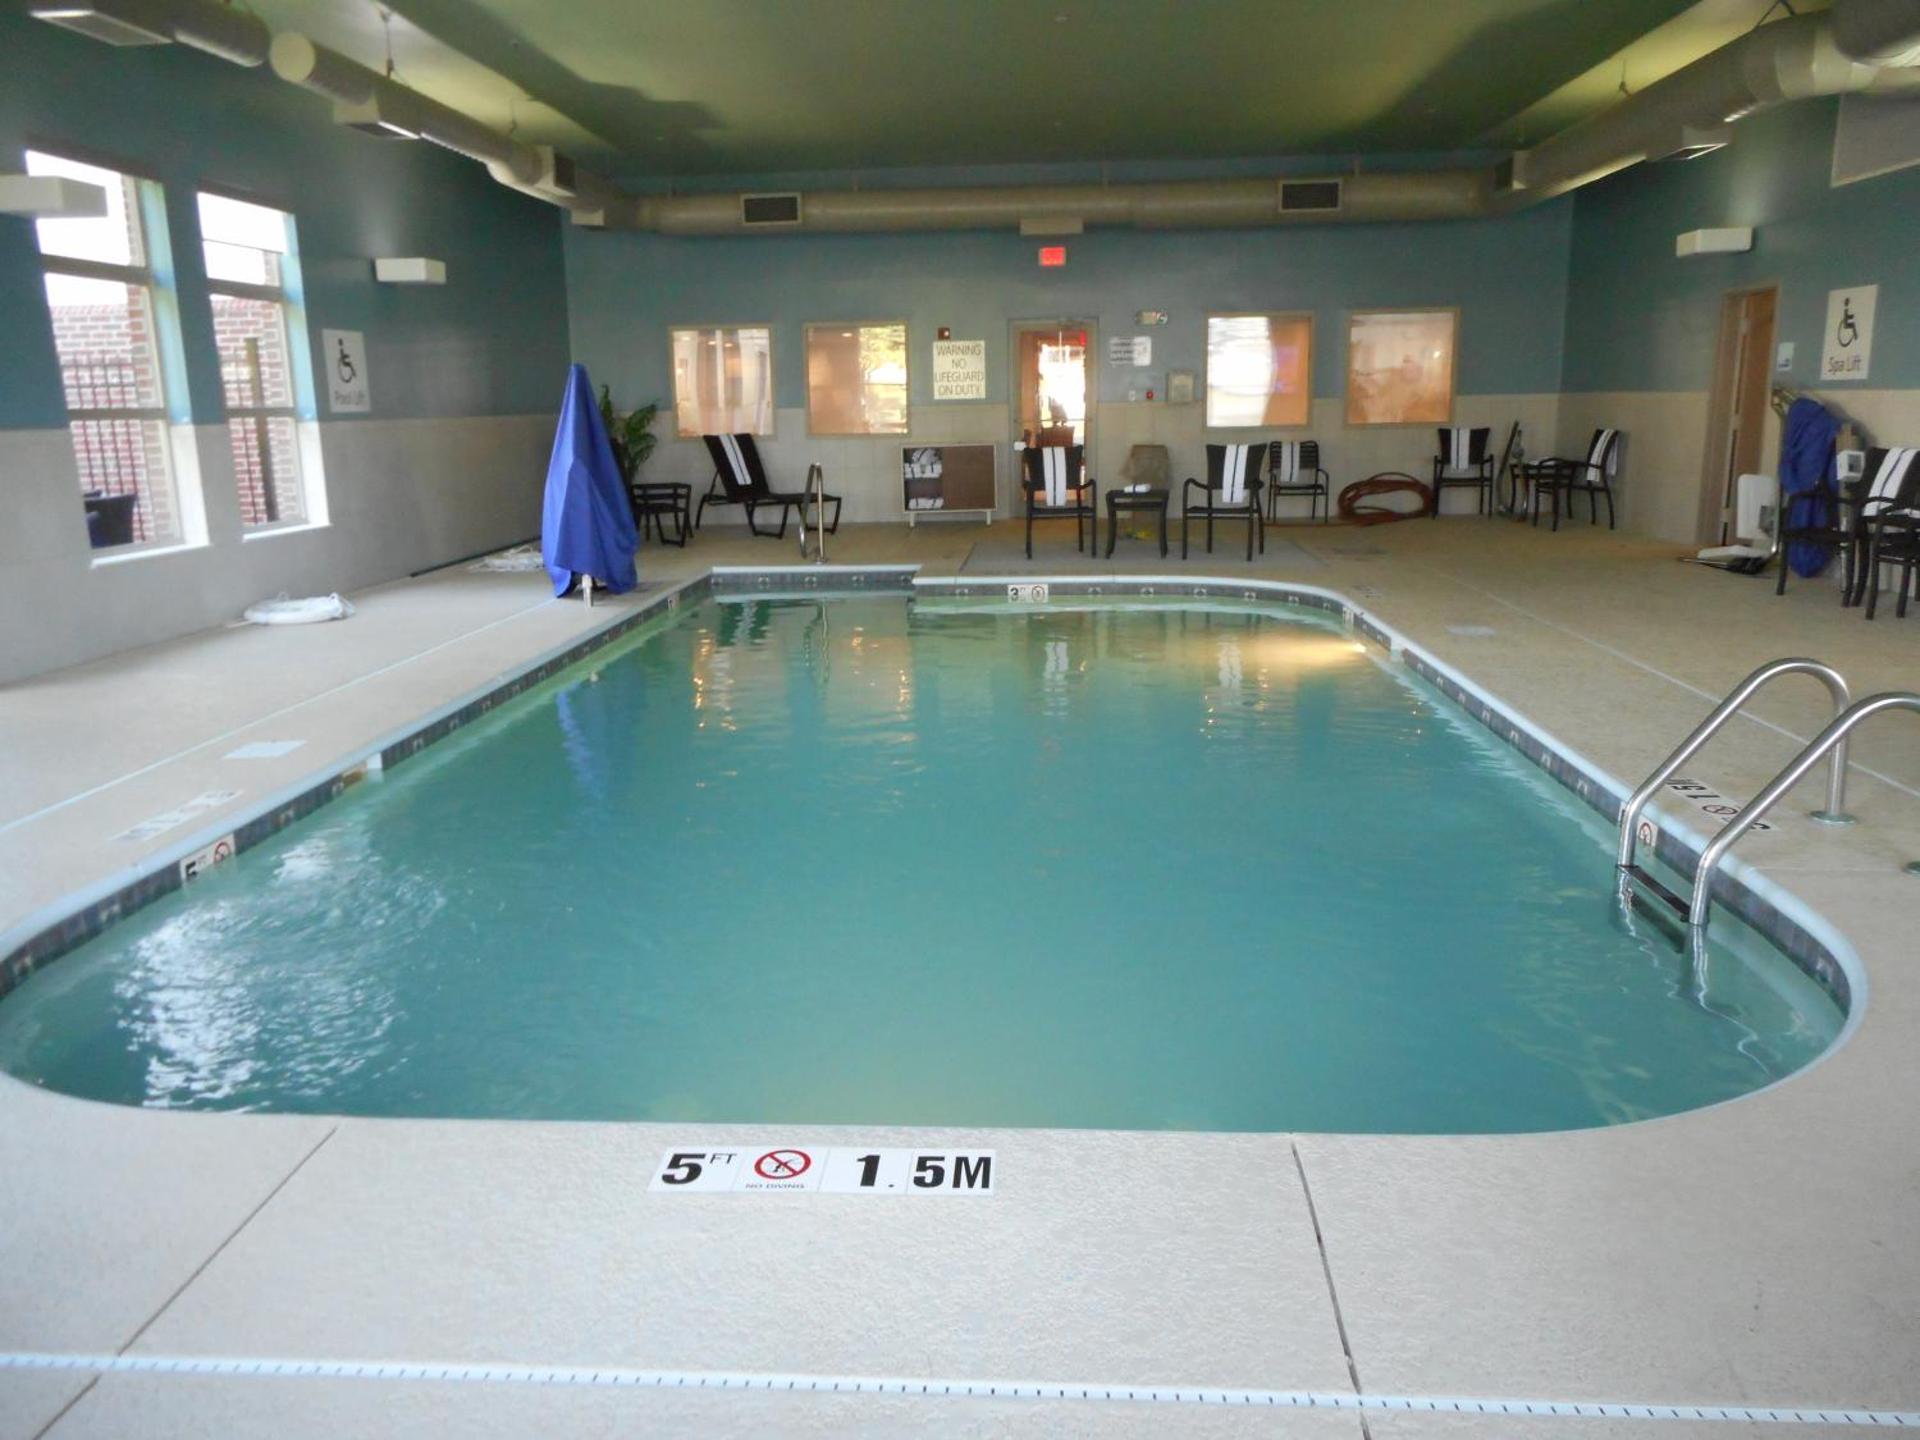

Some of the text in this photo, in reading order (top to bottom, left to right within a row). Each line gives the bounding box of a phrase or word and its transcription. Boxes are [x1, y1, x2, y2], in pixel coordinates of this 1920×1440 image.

[936, 344, 982, 356] WARNING
[952, 358, 967, 369] NO
[1827, 356, 1845, 375] Spa
[935, 371, 984, 382] LIFEGUARD
[938, 384, 981, 396] ON DUTY
